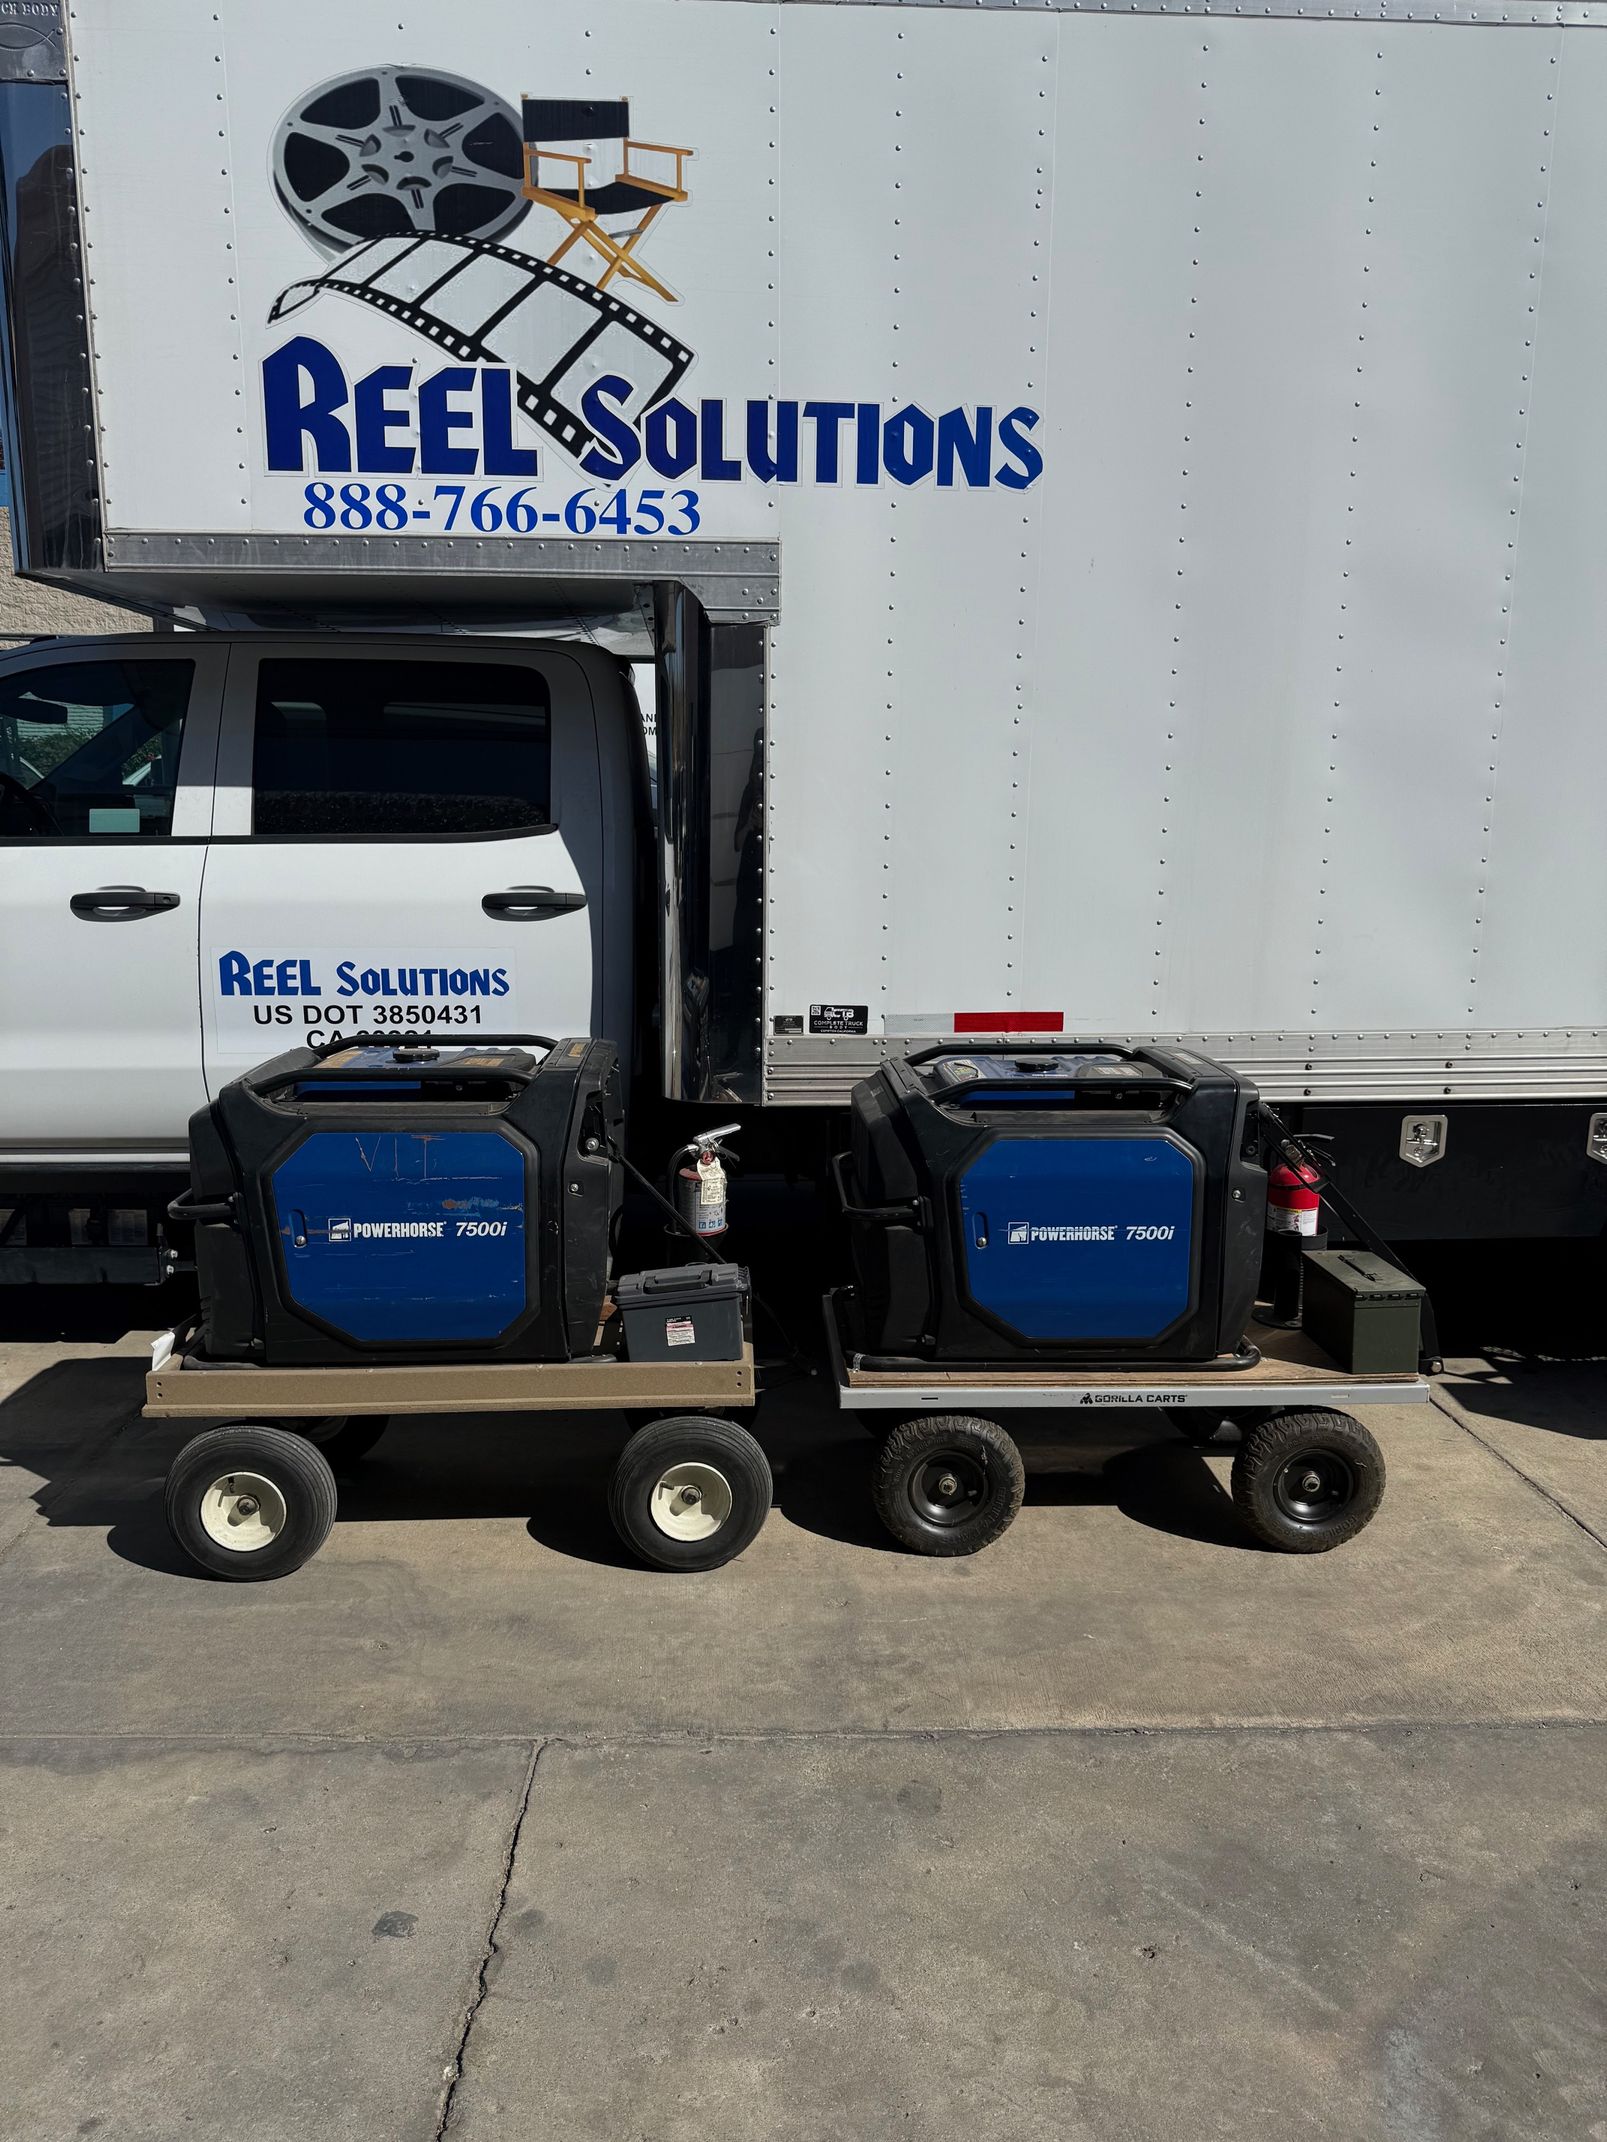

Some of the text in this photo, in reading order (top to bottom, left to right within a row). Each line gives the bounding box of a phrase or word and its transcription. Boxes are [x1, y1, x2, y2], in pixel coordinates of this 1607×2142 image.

[21, 3, 59, 16] BODY
[262, 336, 1044, 490] REEL SOLUTIONS
[303, 482, 700, 536] 888-766-6453
[219, 950, 510, 997] REEL SOLUTIONS
[253, 1004, 481, 1025] US DOT 3850431
[353, 1221, 508, 1239] POWERHORSE 7500i
[1030, 1225, 1176, 1241] POWERHORSE 7500i
[1094, 1394, 1187, 1403] GORILLA CARTS
